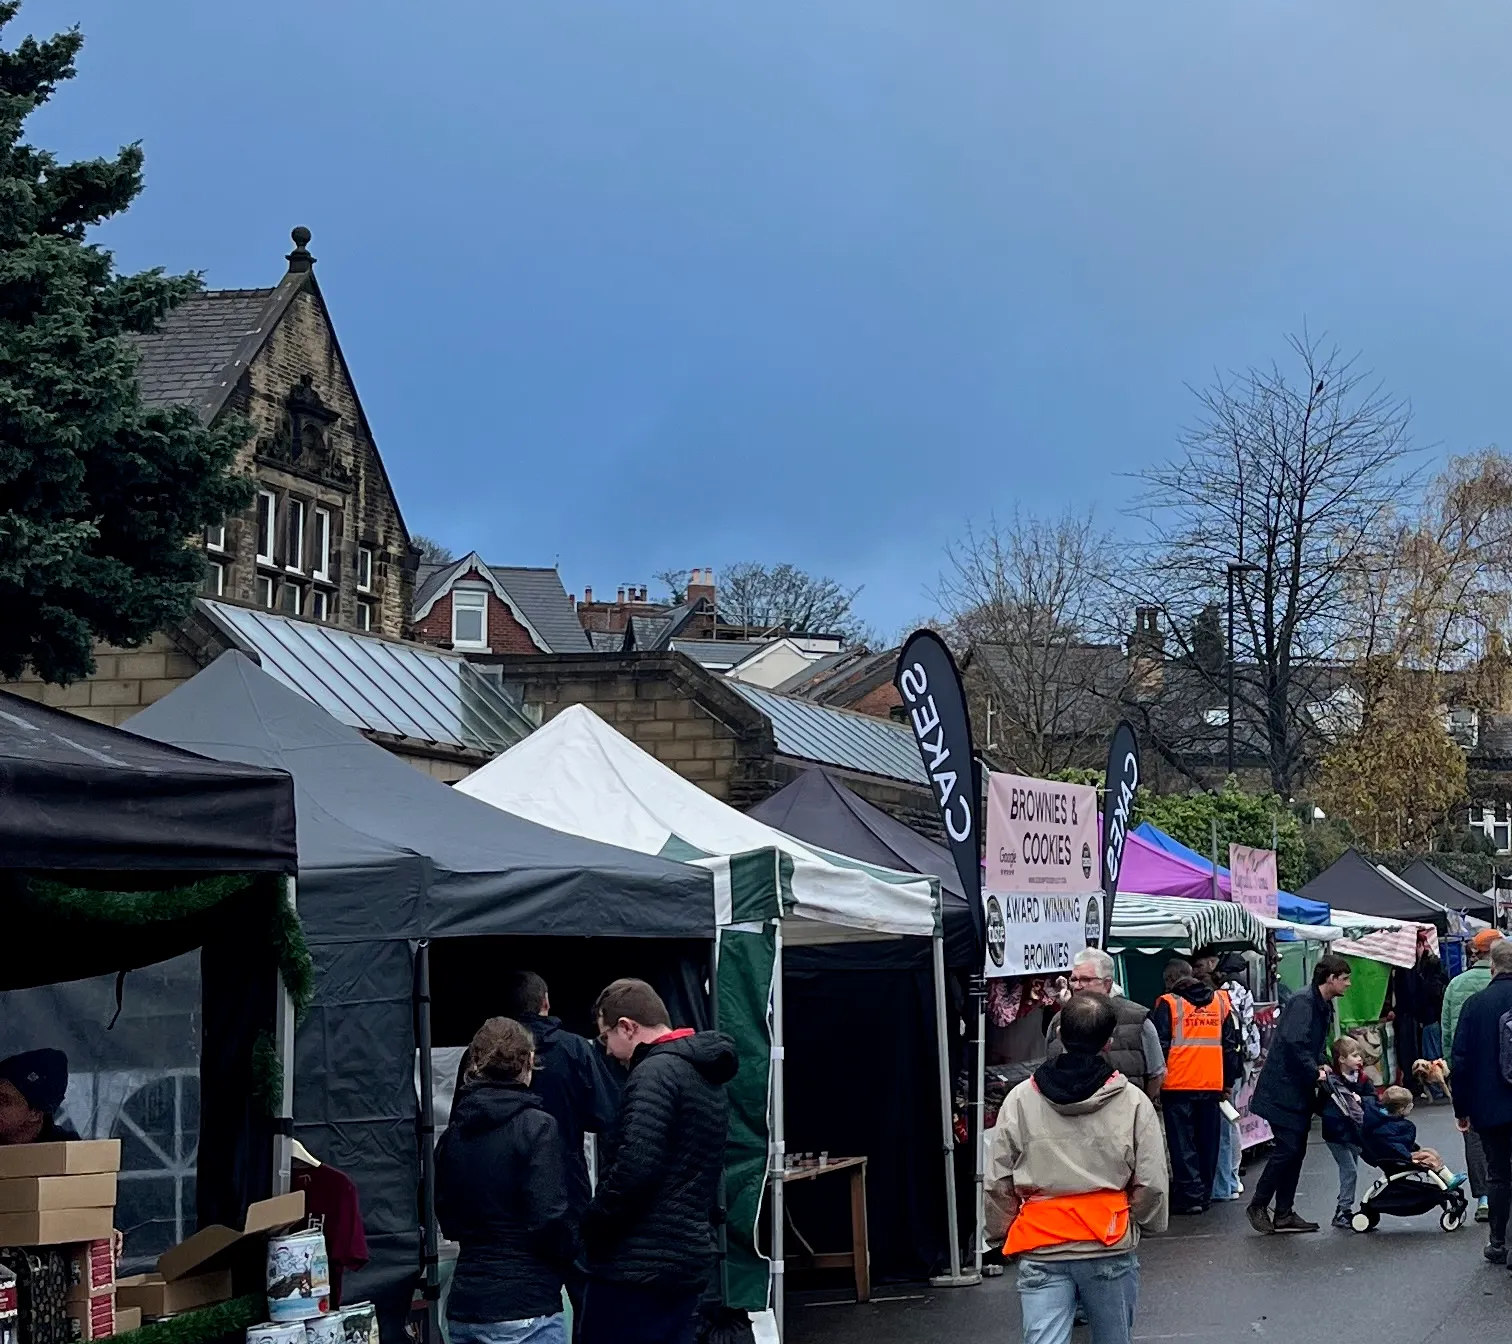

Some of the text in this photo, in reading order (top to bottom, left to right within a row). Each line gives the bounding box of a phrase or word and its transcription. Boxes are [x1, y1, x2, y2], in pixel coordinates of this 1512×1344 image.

[1010, 788, 1079, 825] BROWNIES &
[1022, 832, 1072, 865] COOKIES
[1006, 896, 1080, 923] AWARD WINNING
[1023, 942, 1069, 970] BROWNIES
